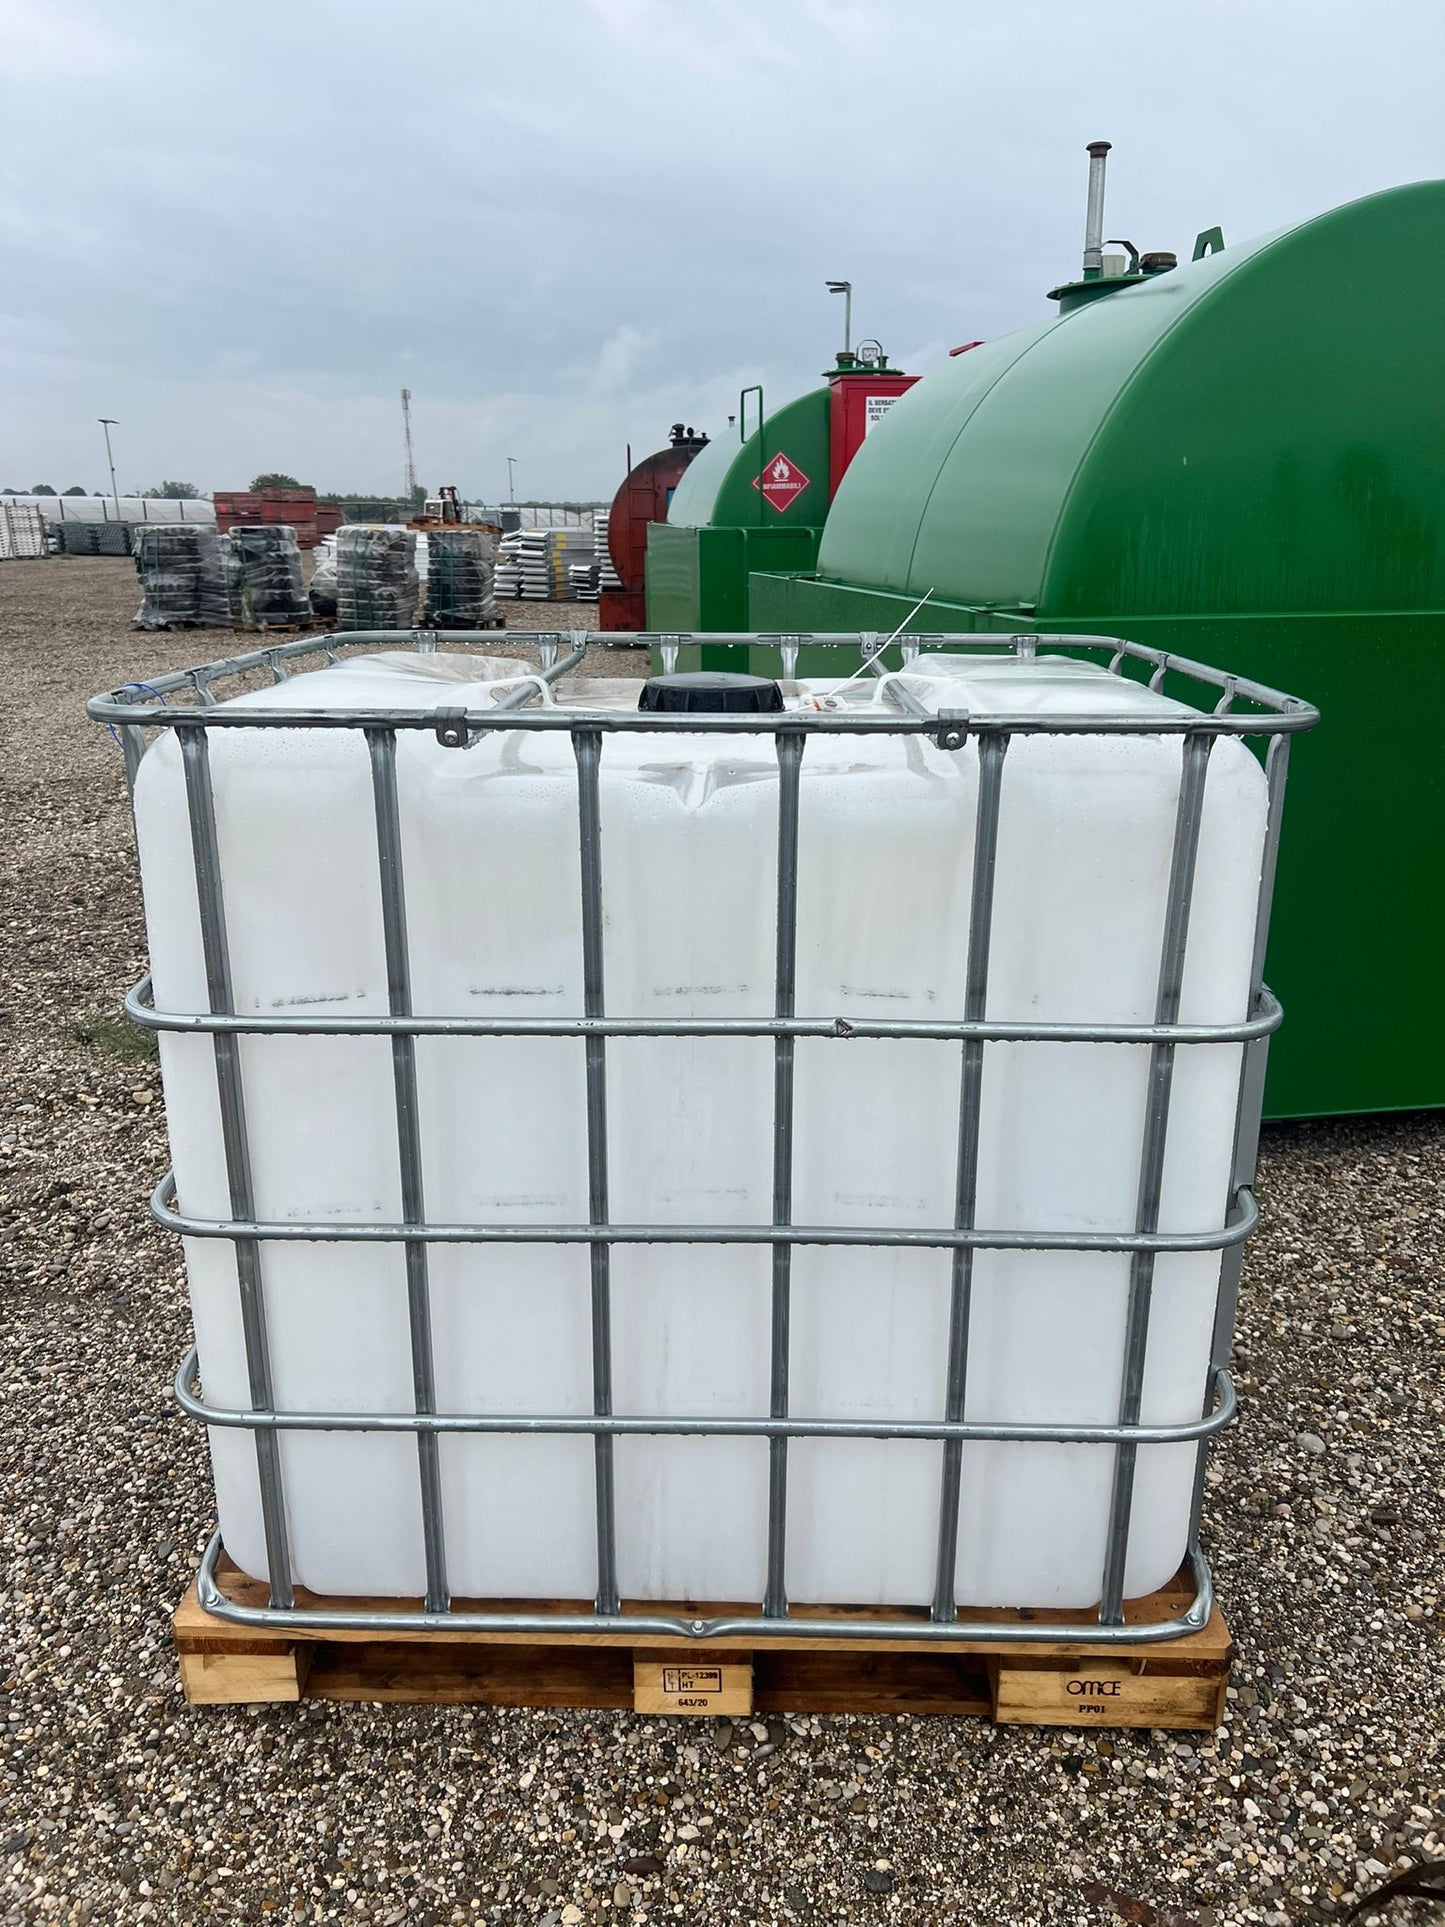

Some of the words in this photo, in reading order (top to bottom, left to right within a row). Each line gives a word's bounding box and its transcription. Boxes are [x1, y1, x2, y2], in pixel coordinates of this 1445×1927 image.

[762, 482, 801, 490] NFIAMMABILI
[682, 1680, 694, 1689] HT
[678, 1698, 708, 1707] 643/20
[1079, 1704, 1106, 1714] PP01
